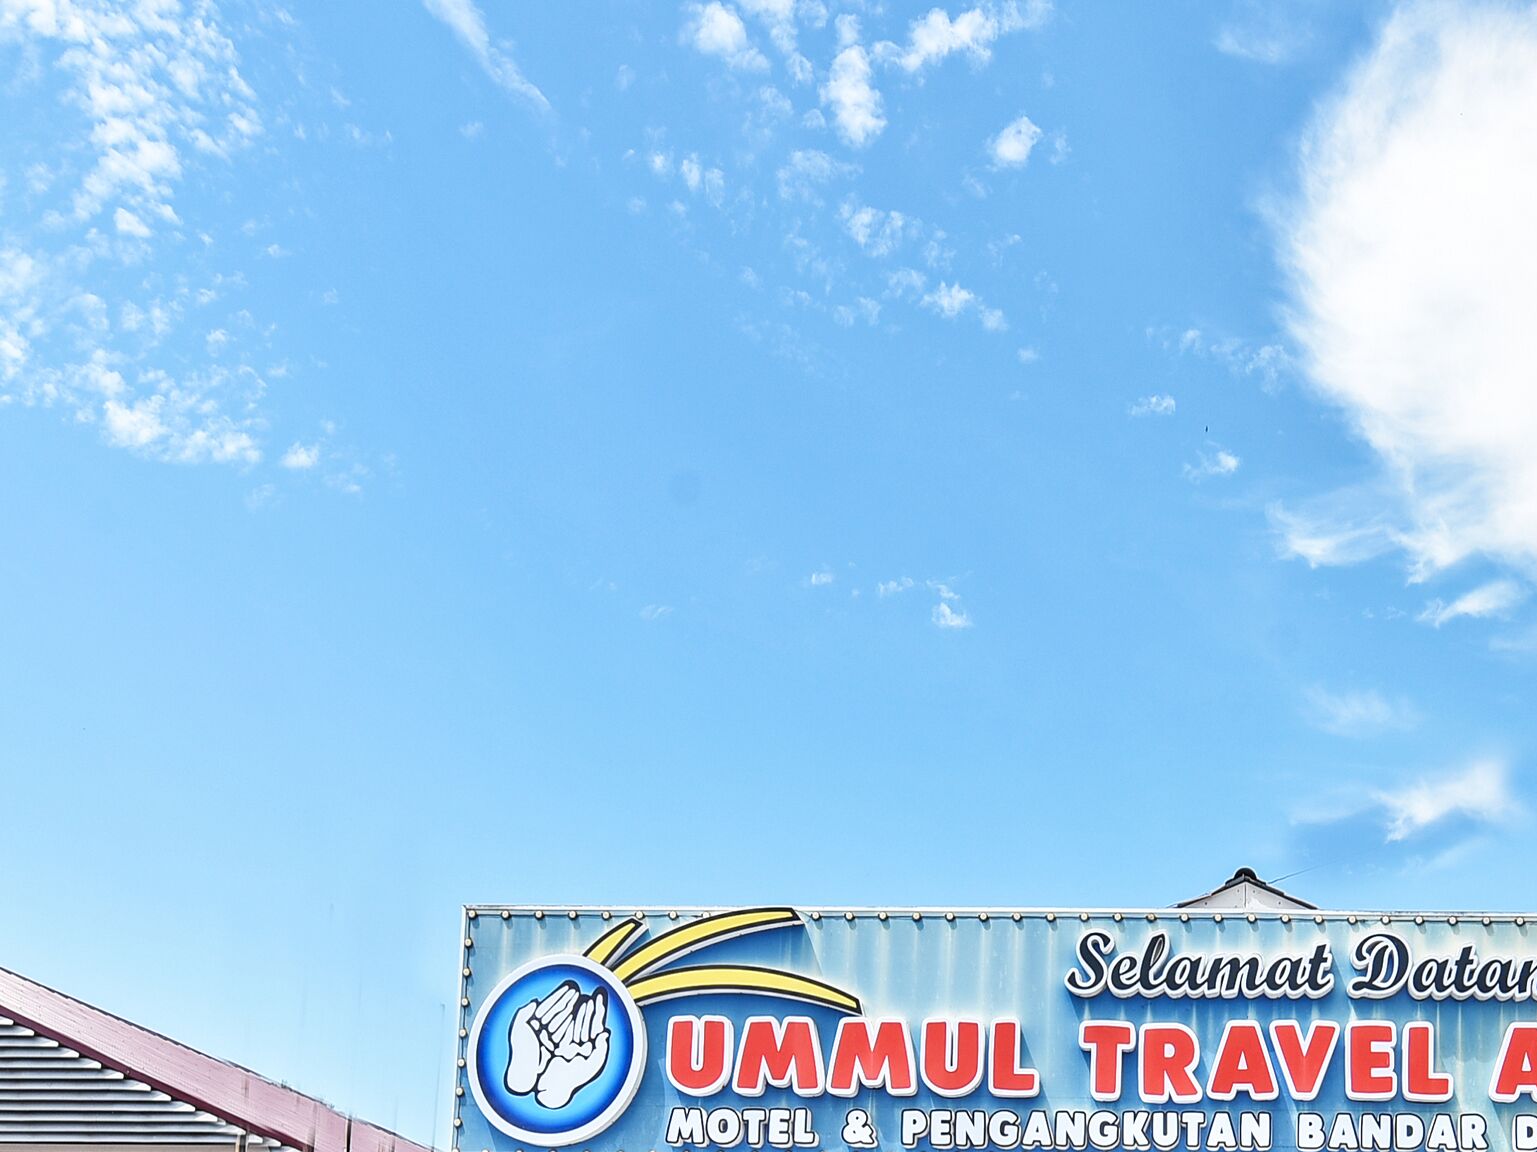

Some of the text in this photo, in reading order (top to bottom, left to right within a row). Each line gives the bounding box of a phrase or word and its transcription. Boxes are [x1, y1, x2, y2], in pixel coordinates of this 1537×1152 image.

[1066, 931, 1333, 994] Selamat
[667, 1020, 1037, 1097] UMMUL
[1082, 1024, 1450, 1099] TRAVEL
[668, 1109, 816, 1147] MOTEL
[842, 1110, 877, 1147] &
[902, 1111, 1271, 1151] PENGANGKUTAN
[1298, 1113, 1488, 1152] BANDAR
